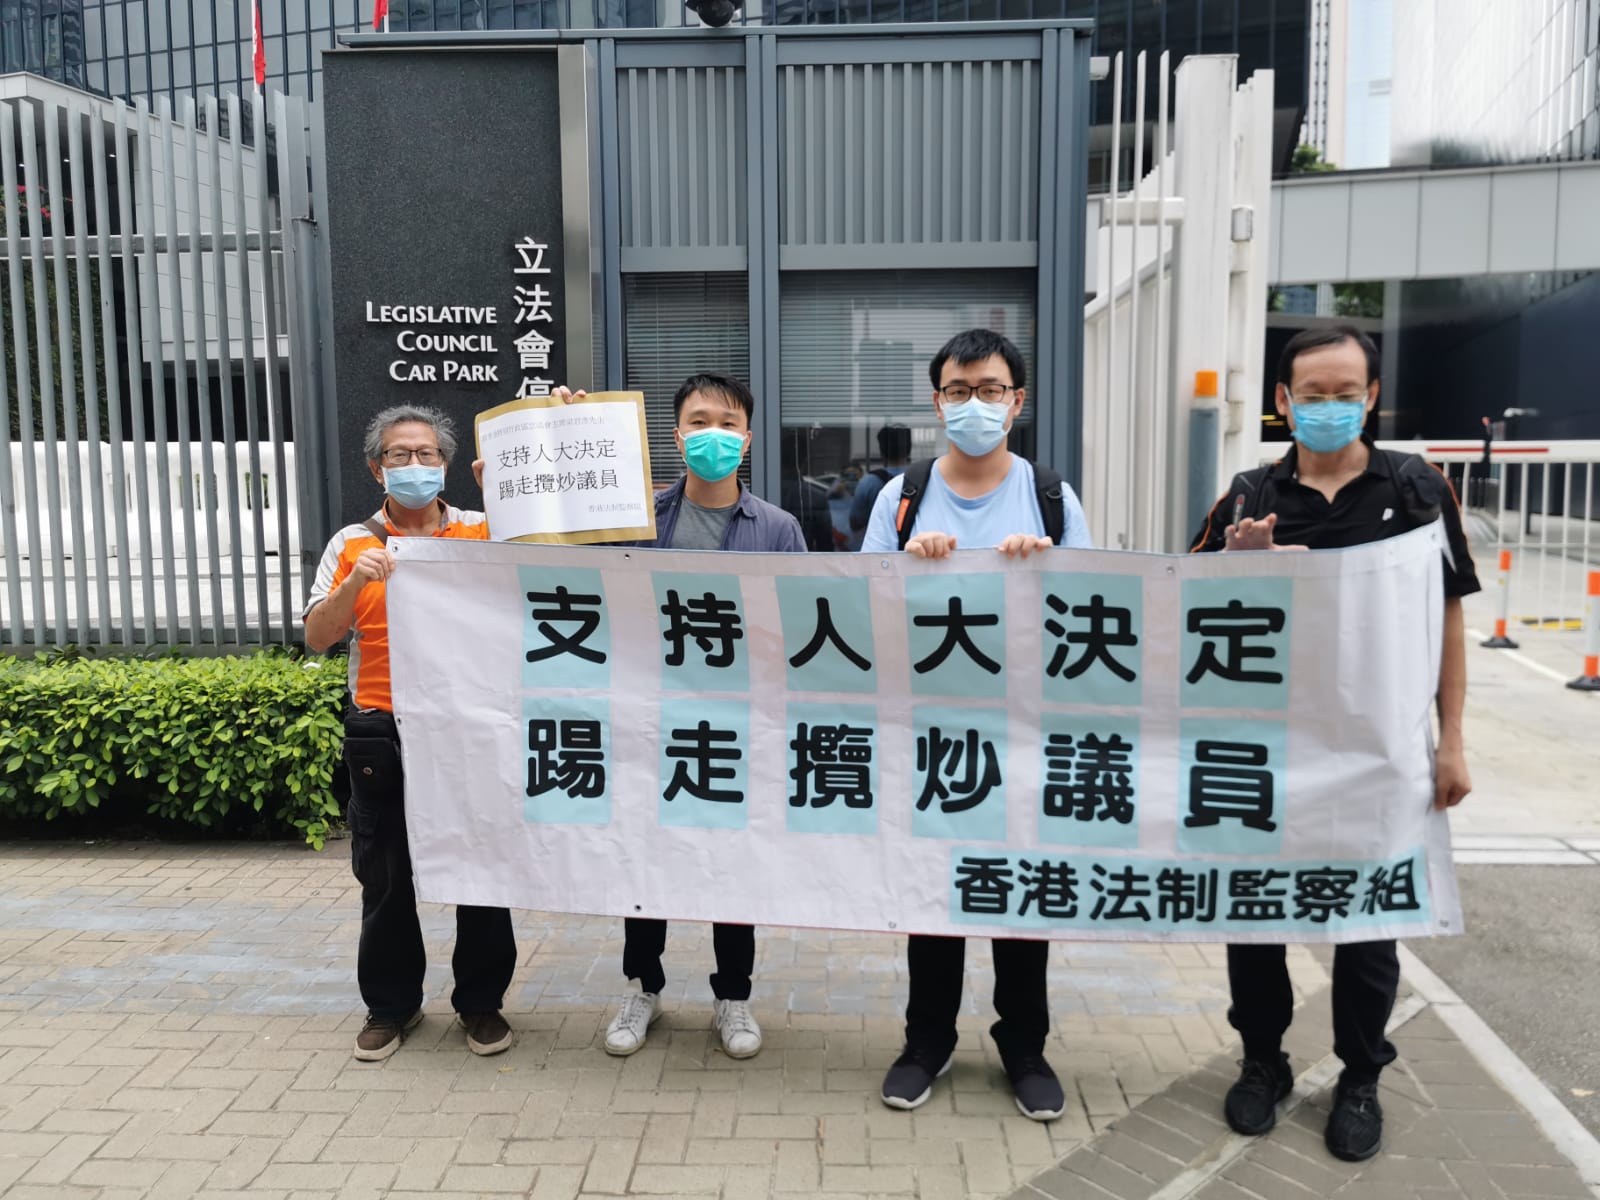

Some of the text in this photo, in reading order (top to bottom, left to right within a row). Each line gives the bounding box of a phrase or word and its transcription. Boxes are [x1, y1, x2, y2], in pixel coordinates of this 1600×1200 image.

[397, 330, 498, 352] COUNCIL
[389, 360, 499, 382] CAR PARK
[497, 438, 617, 472] 支持人大決定
[526, 585, 1286, 685] 支持人大決定
[954, 855, 1421, 923] 香港法制監察組
